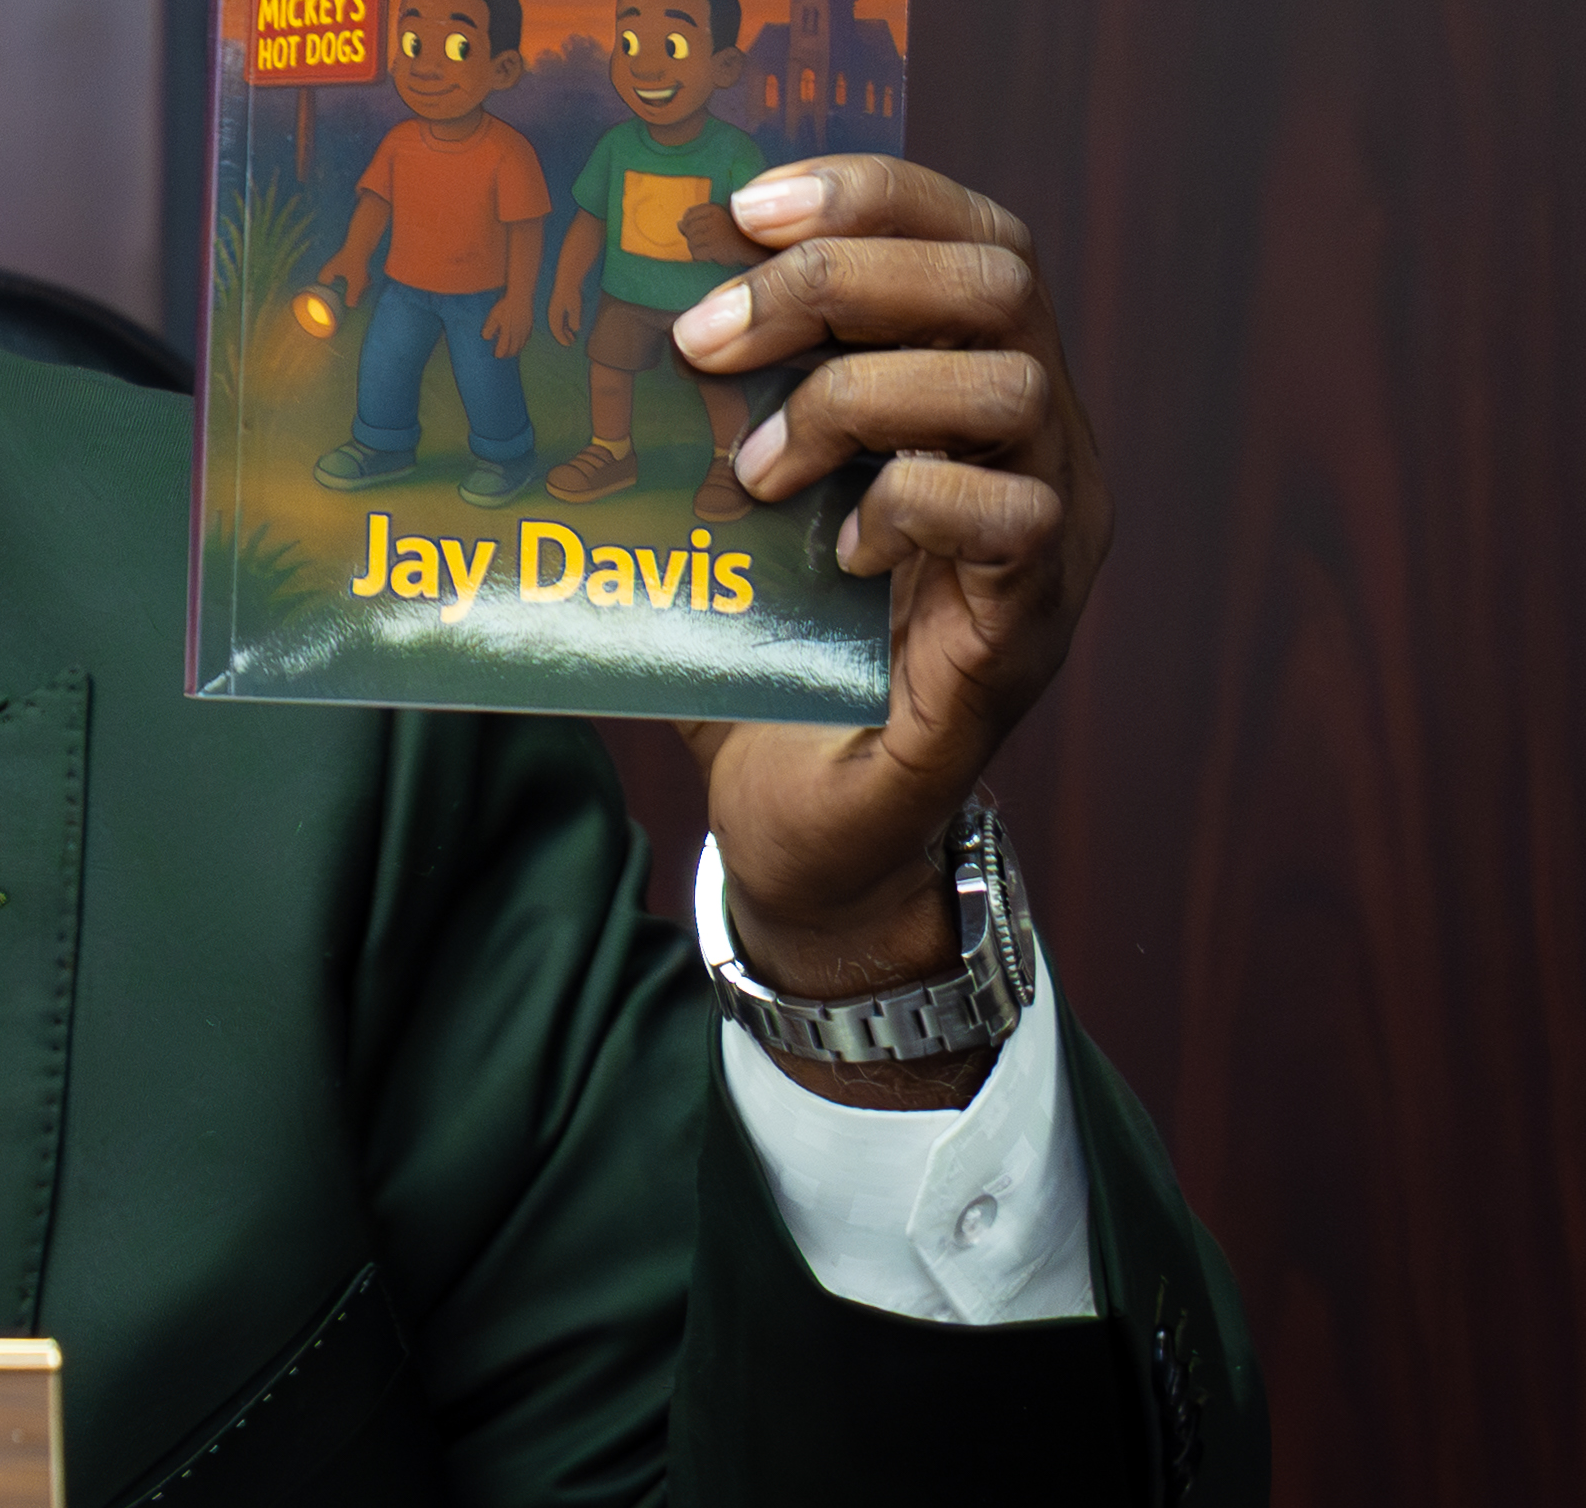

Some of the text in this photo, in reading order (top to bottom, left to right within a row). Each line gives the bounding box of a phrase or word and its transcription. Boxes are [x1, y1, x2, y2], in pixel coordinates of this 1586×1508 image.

[257, 28, 367, 71] HOT DOGS
[350, 511, 755, 625] Jay Davis
